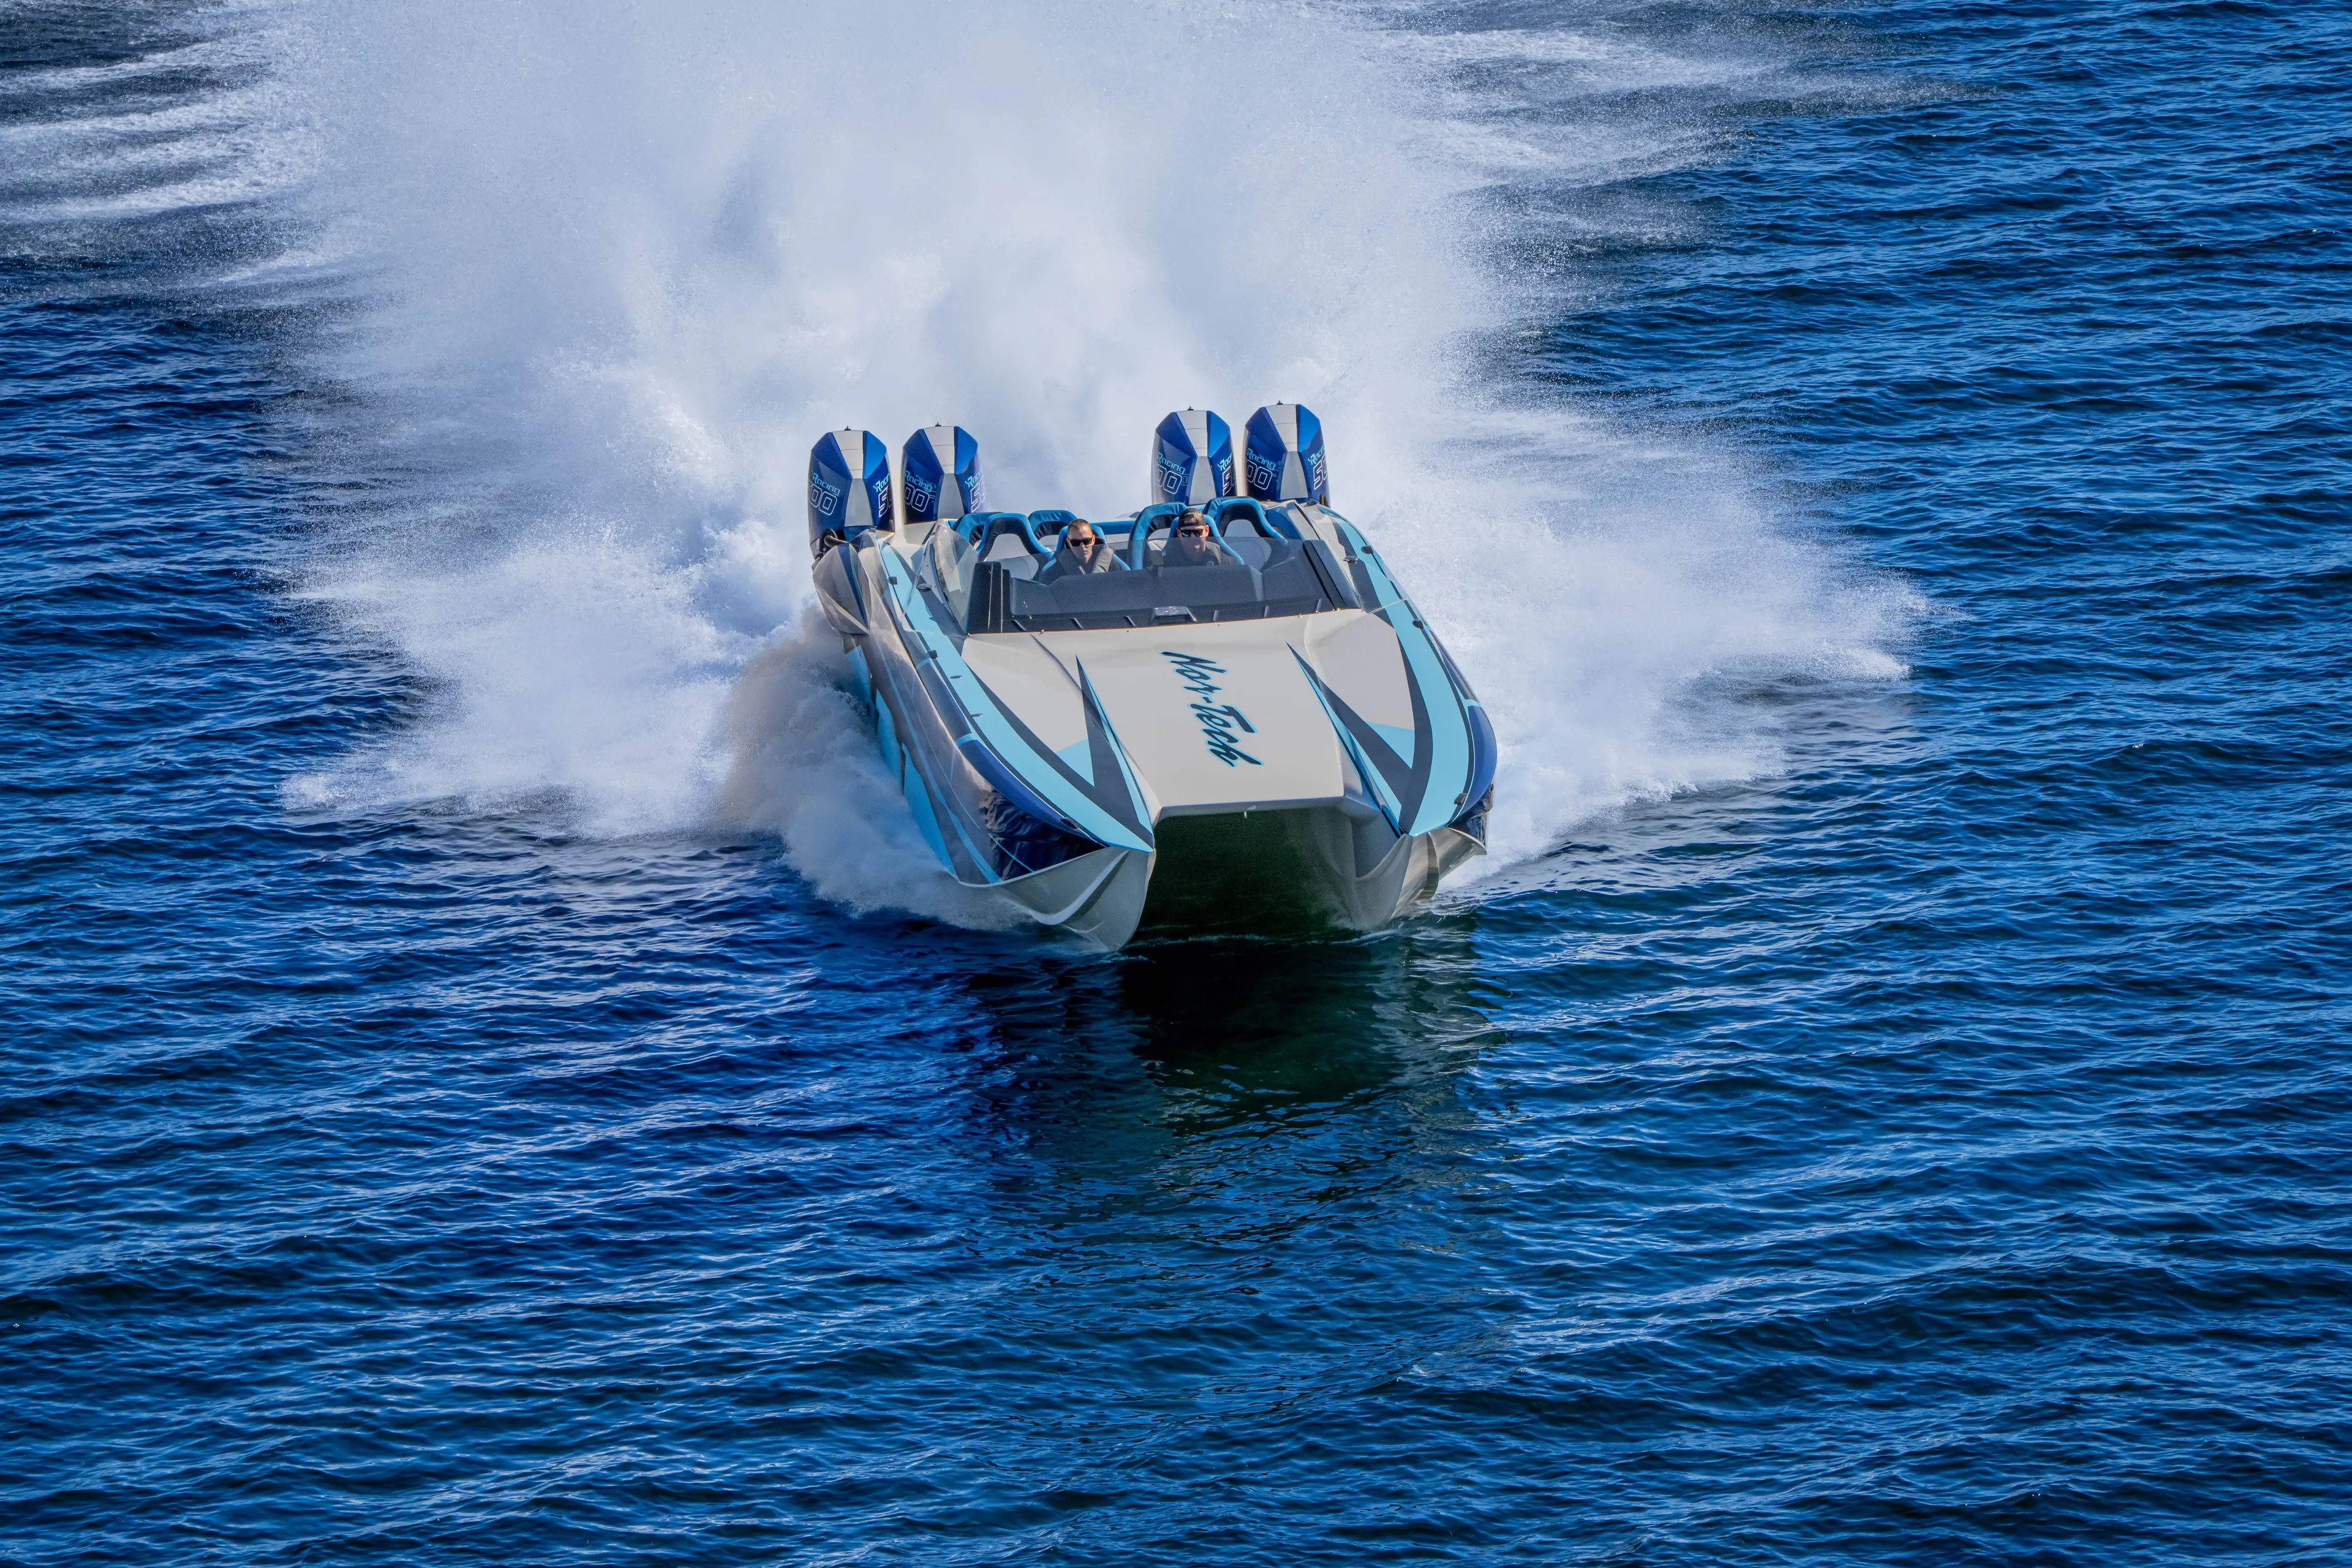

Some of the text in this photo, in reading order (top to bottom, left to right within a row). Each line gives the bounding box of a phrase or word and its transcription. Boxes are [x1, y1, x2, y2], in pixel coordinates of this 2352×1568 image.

[1156, 451, 1185, 474] Racing
[812, 471, 840, 496] Racing
[1159, 650, 1264, 767] Nor-Tech
